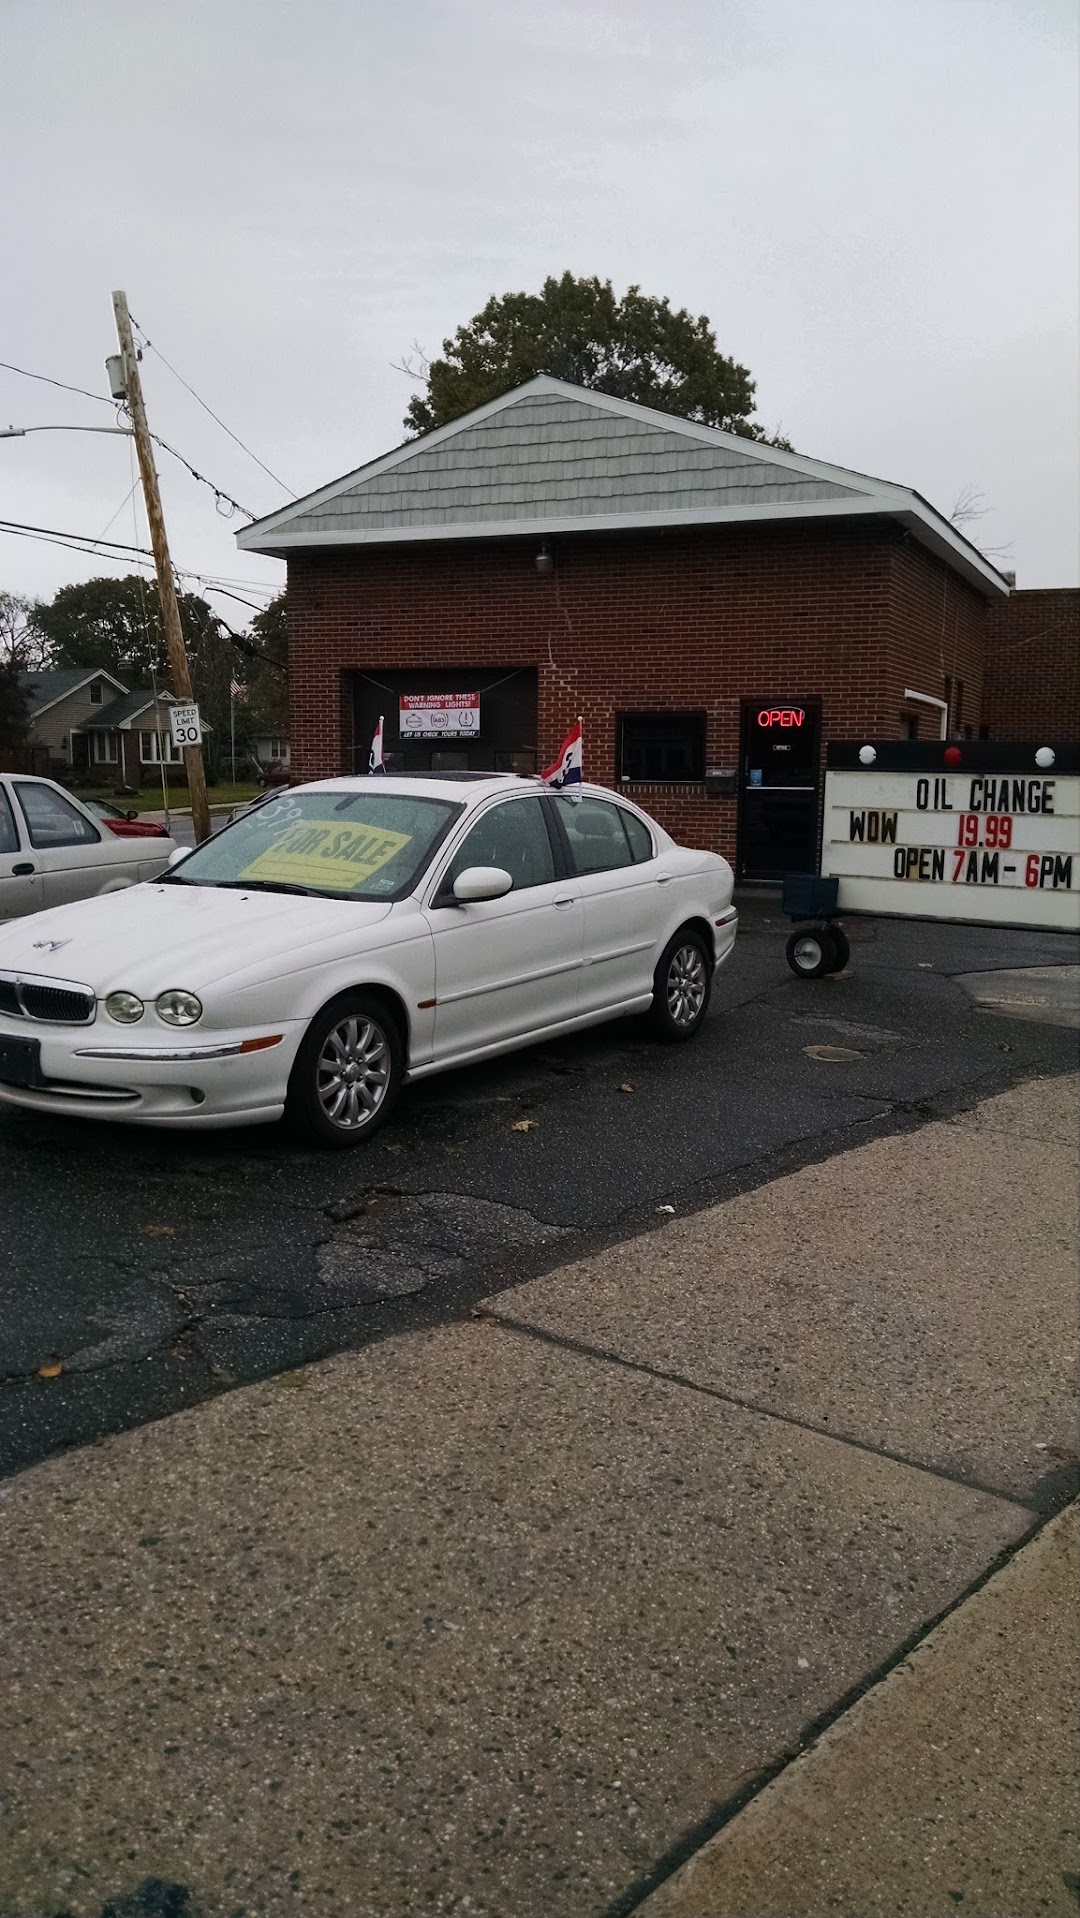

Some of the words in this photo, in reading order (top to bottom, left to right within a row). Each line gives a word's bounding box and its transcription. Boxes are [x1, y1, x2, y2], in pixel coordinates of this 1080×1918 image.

[173, 709, 196, 718] SPEED
[176, 717, 194, 726] LIMIT
[758, 710, 803, 727] OPEN
[176, 727, 198, 743] 30
[916, 778, 953, 810] OIL
[969, 779, 1056, 814] CHANGE
[850, 811, 898, 843] WOW
[958, 814, 1013, 848] 19.99
[320, 831, 397, 866] SALE
[894, 848, 945, 880] OPEN
